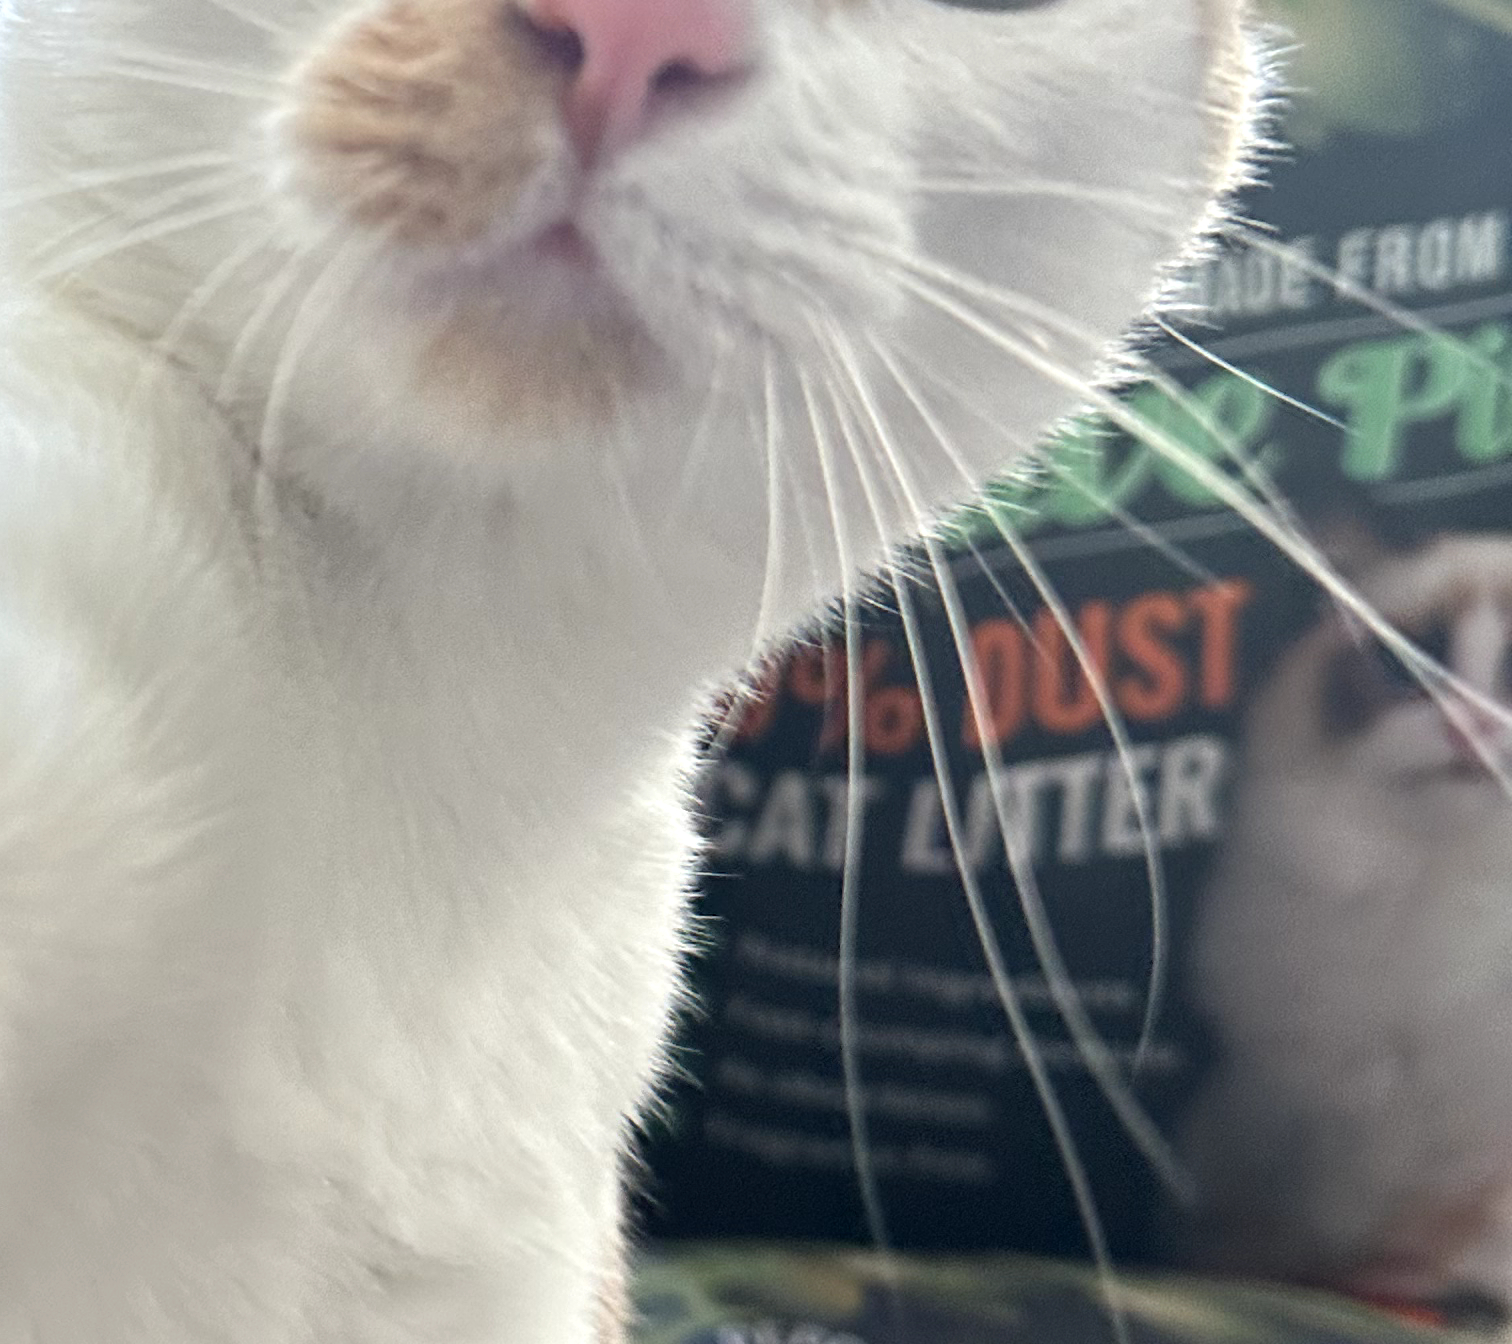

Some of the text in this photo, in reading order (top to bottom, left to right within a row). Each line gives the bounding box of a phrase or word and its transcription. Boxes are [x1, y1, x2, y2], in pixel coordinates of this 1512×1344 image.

[1337, 211, 1506, 298] FROM
[961, 576, 1253, 751] DUST
[702, 735, 1228, 874] CAT LITTER
